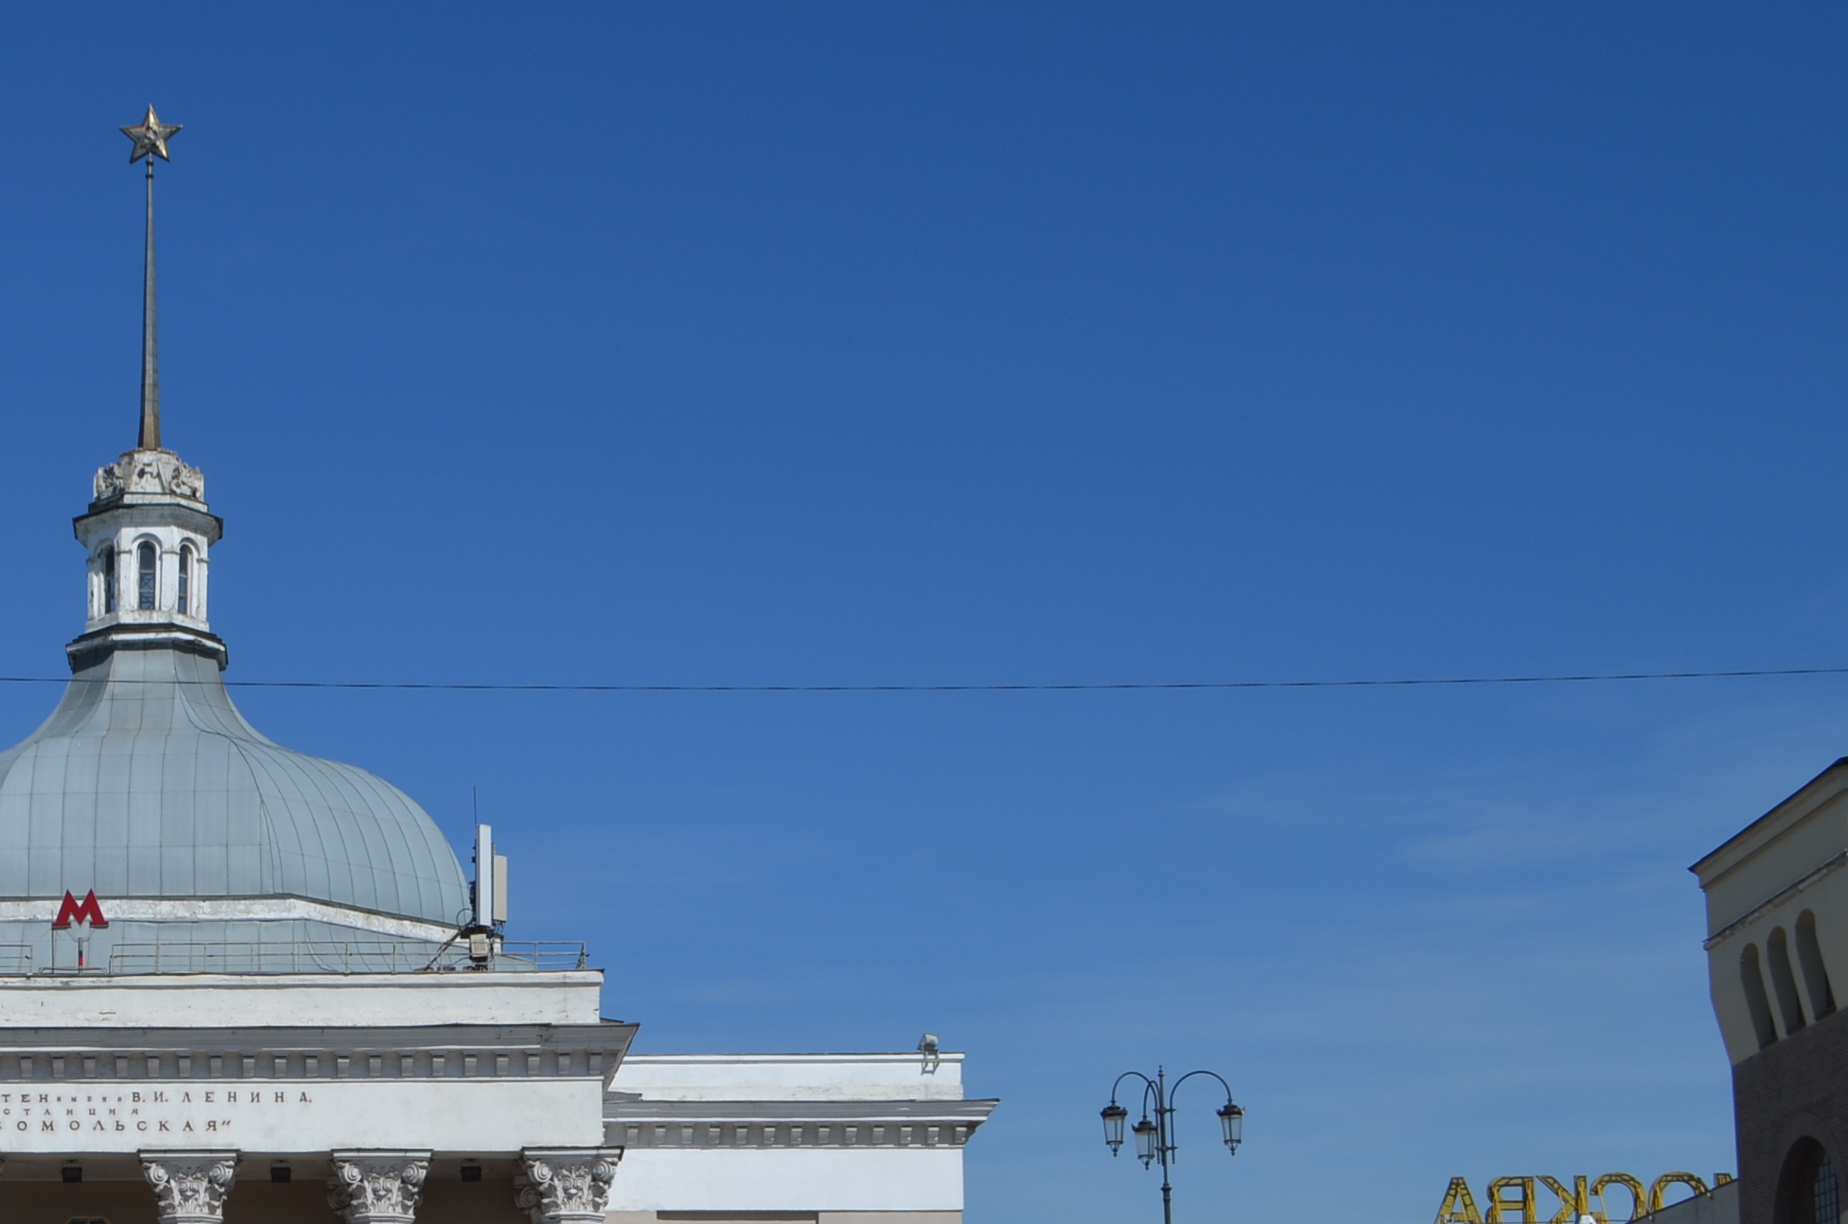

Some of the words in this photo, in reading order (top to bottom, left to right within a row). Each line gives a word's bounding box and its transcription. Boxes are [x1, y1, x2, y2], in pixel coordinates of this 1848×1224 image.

[132, 1092, 146, 1103] В.
[154, 1092, 168, 1103] И.
[181, 1091, 312, 1103] ЛЕНИНА.
[2, 1107, 139, 1116] СТАНЦИЯ
